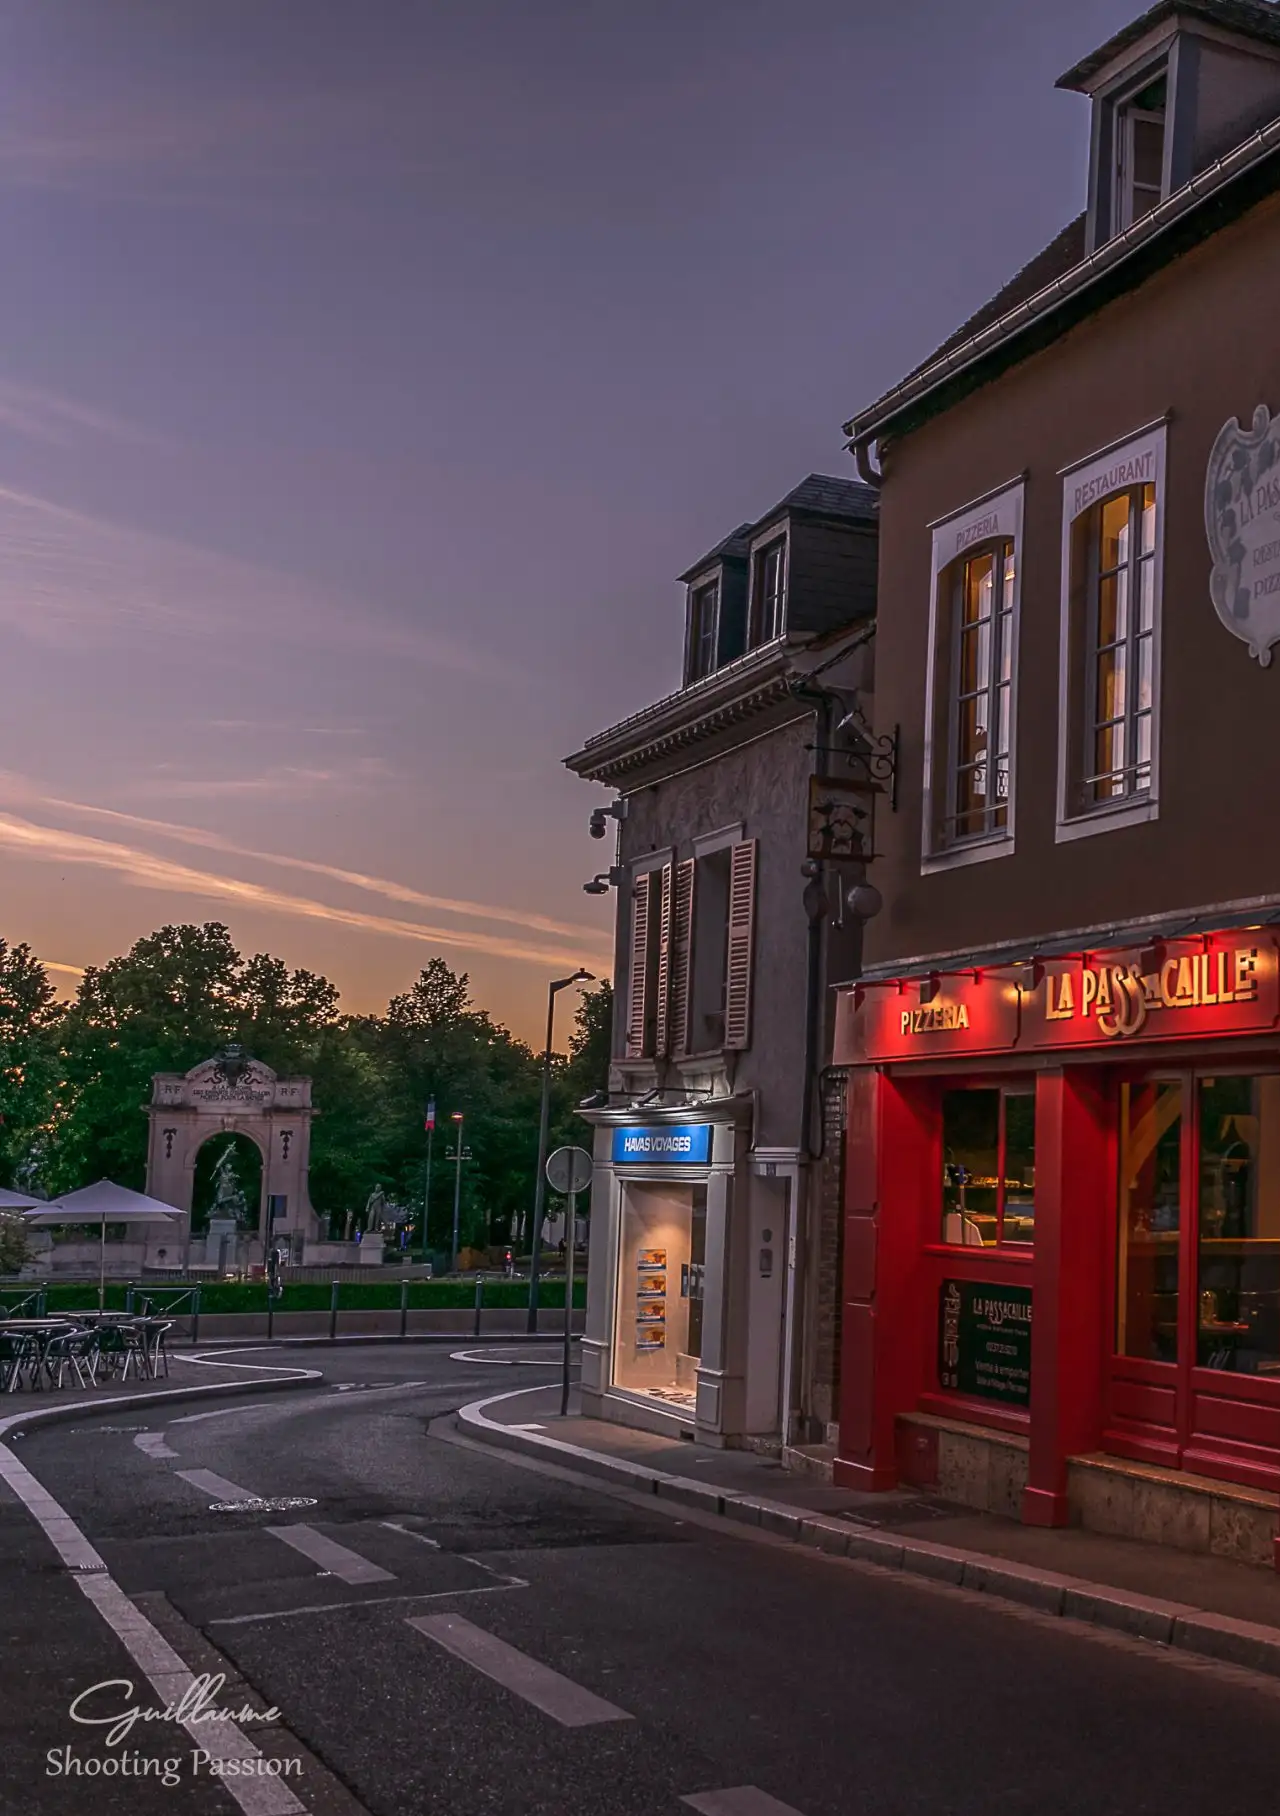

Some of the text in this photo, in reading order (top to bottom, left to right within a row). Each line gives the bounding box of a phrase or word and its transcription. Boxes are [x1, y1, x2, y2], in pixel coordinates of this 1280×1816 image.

[1074, 451, 1153, 513] RESTAURANT
[1240, 500, 1255, 527] LA
[956, 513, 999, 553] PIZZERIA
[1045, 948, 1257, 1036] LA PASSACAILLE
[901, 1003, 970, 1036] PIZZERIA
[624, 1135, 691, 1152] HAVAS VOYAGES
[973, 1297, 1033, 1325] LA PASSACAILLE
